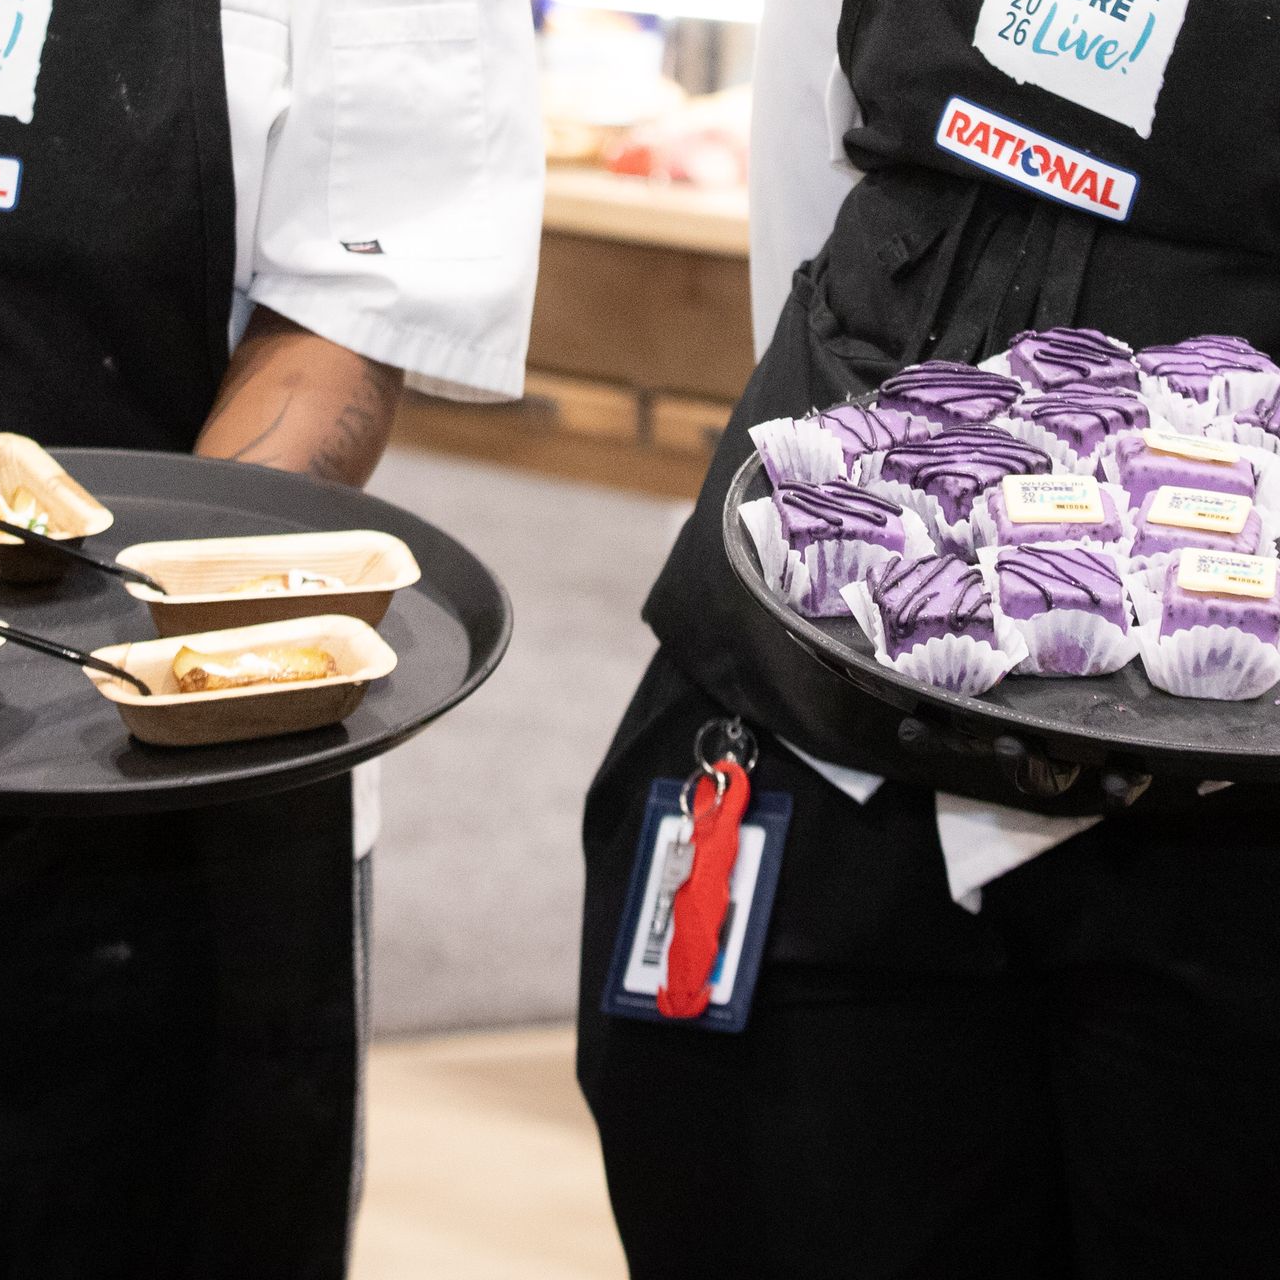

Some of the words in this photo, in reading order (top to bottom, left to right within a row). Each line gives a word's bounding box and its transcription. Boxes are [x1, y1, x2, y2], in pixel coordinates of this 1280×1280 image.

[998, 12, 1031, 46] 26
[1032, 2, 1156, 75] Live!
[945, 110, 1120, 210] RATIONAL
